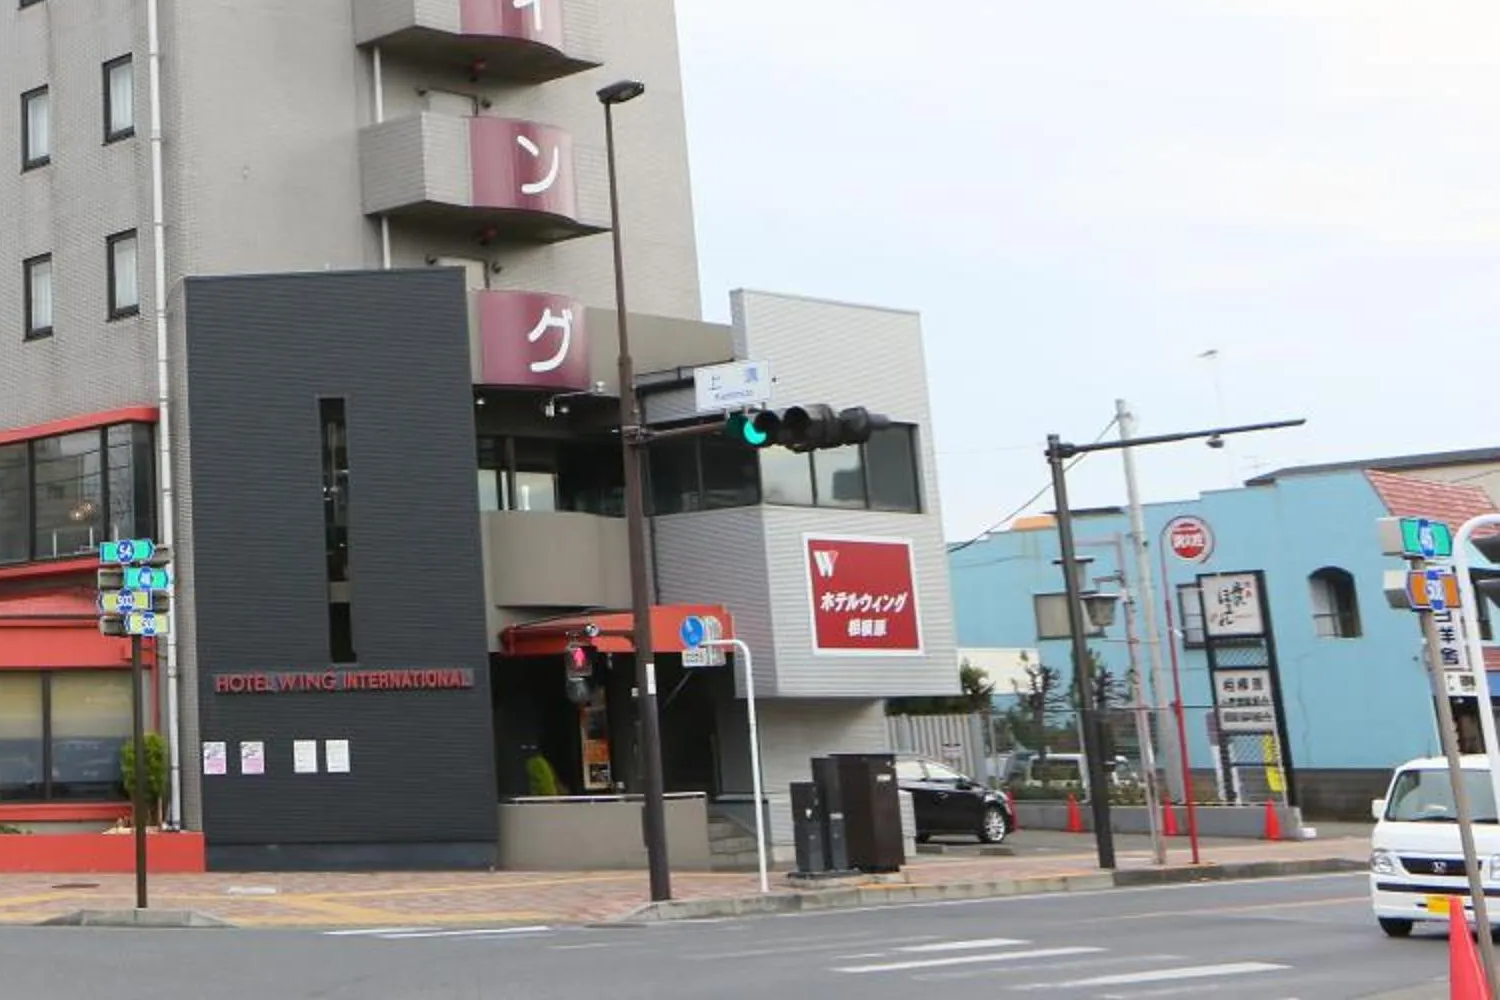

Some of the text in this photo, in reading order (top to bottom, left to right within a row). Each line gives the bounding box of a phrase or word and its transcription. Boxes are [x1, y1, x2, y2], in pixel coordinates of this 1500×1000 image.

[216, 668, 473, 692] HOTEL WING INTERNATIONAL
